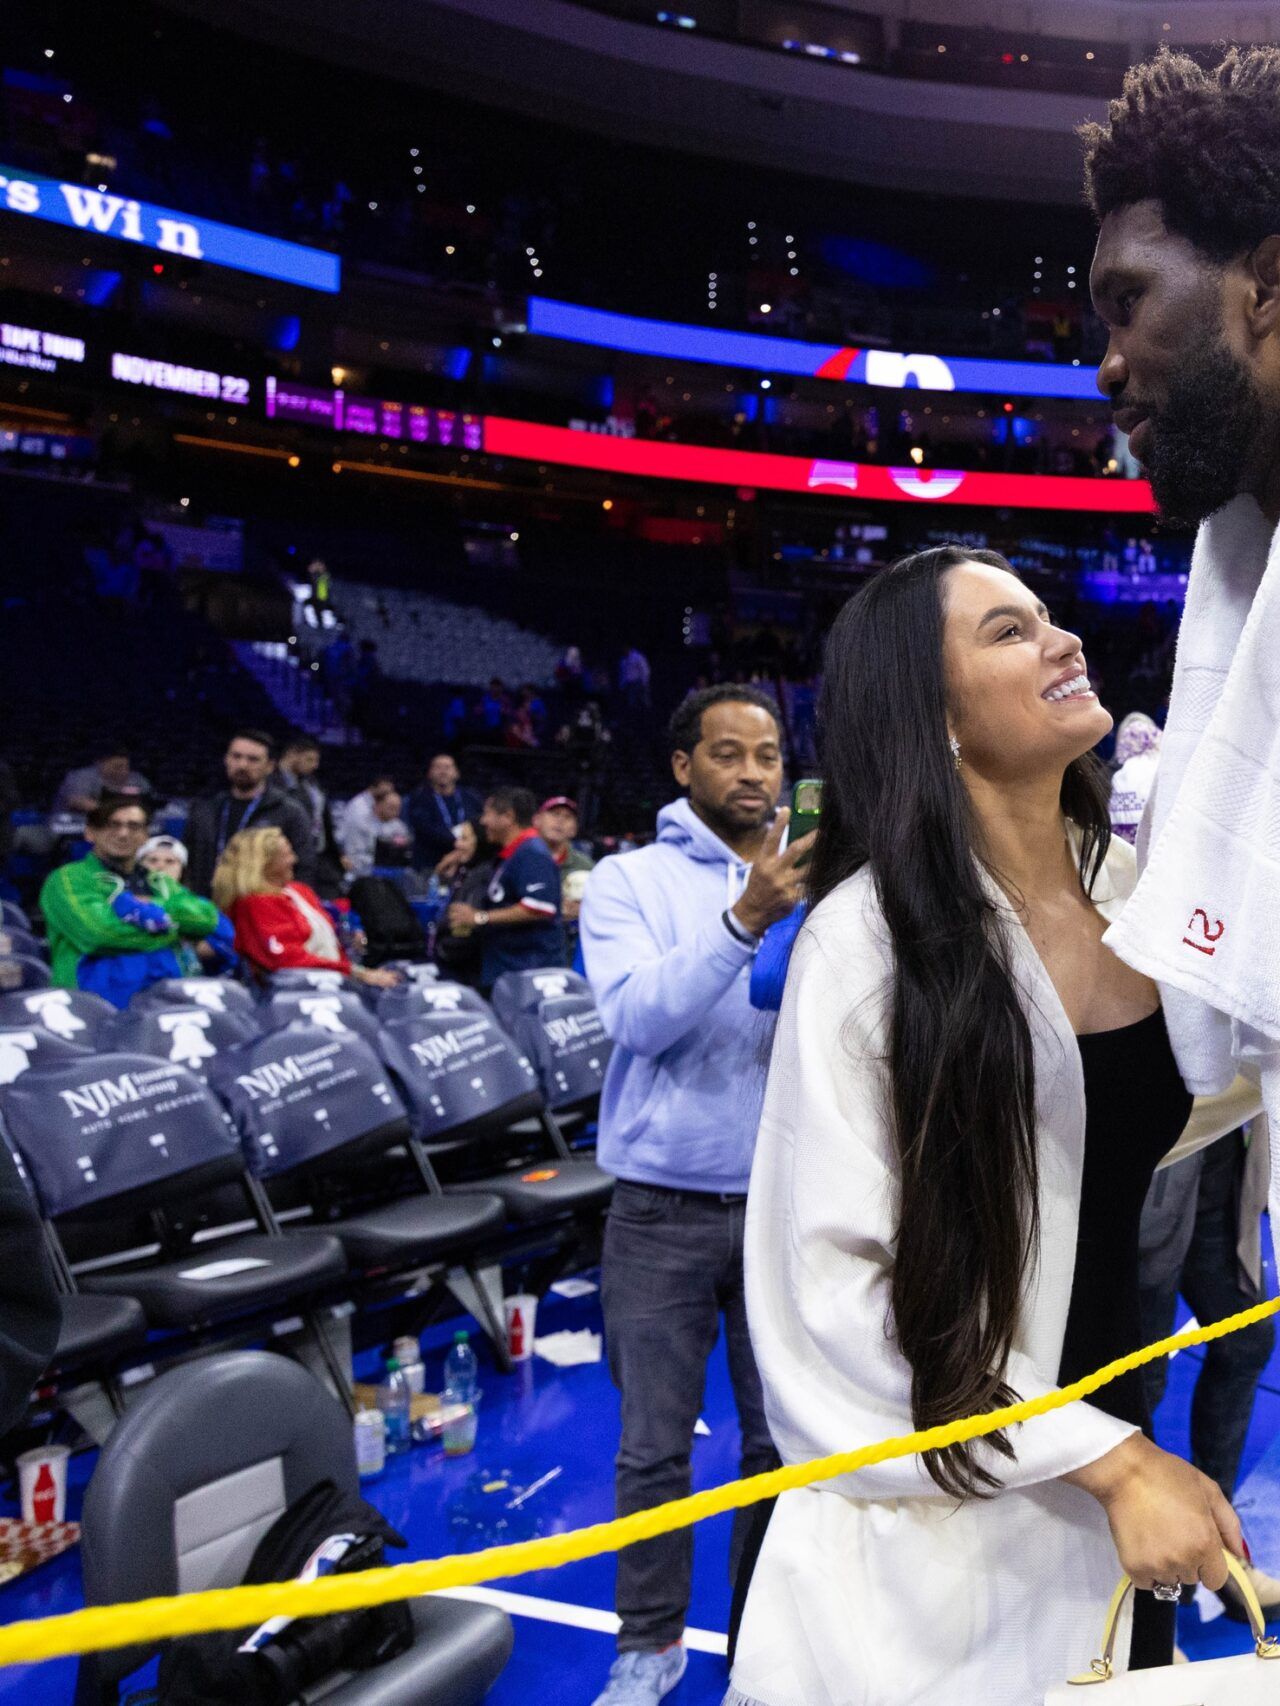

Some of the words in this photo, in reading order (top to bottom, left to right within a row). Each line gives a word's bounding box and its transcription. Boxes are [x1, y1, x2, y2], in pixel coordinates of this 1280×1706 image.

[112, 352, 220, 399] NOVEMBER
[220, 375, 250, 404] 22
[409, 1030, 461, 1067] NJM
[58, 1073, 142, 1118] NJM
[234, 1056, 304, 1099] NJM
